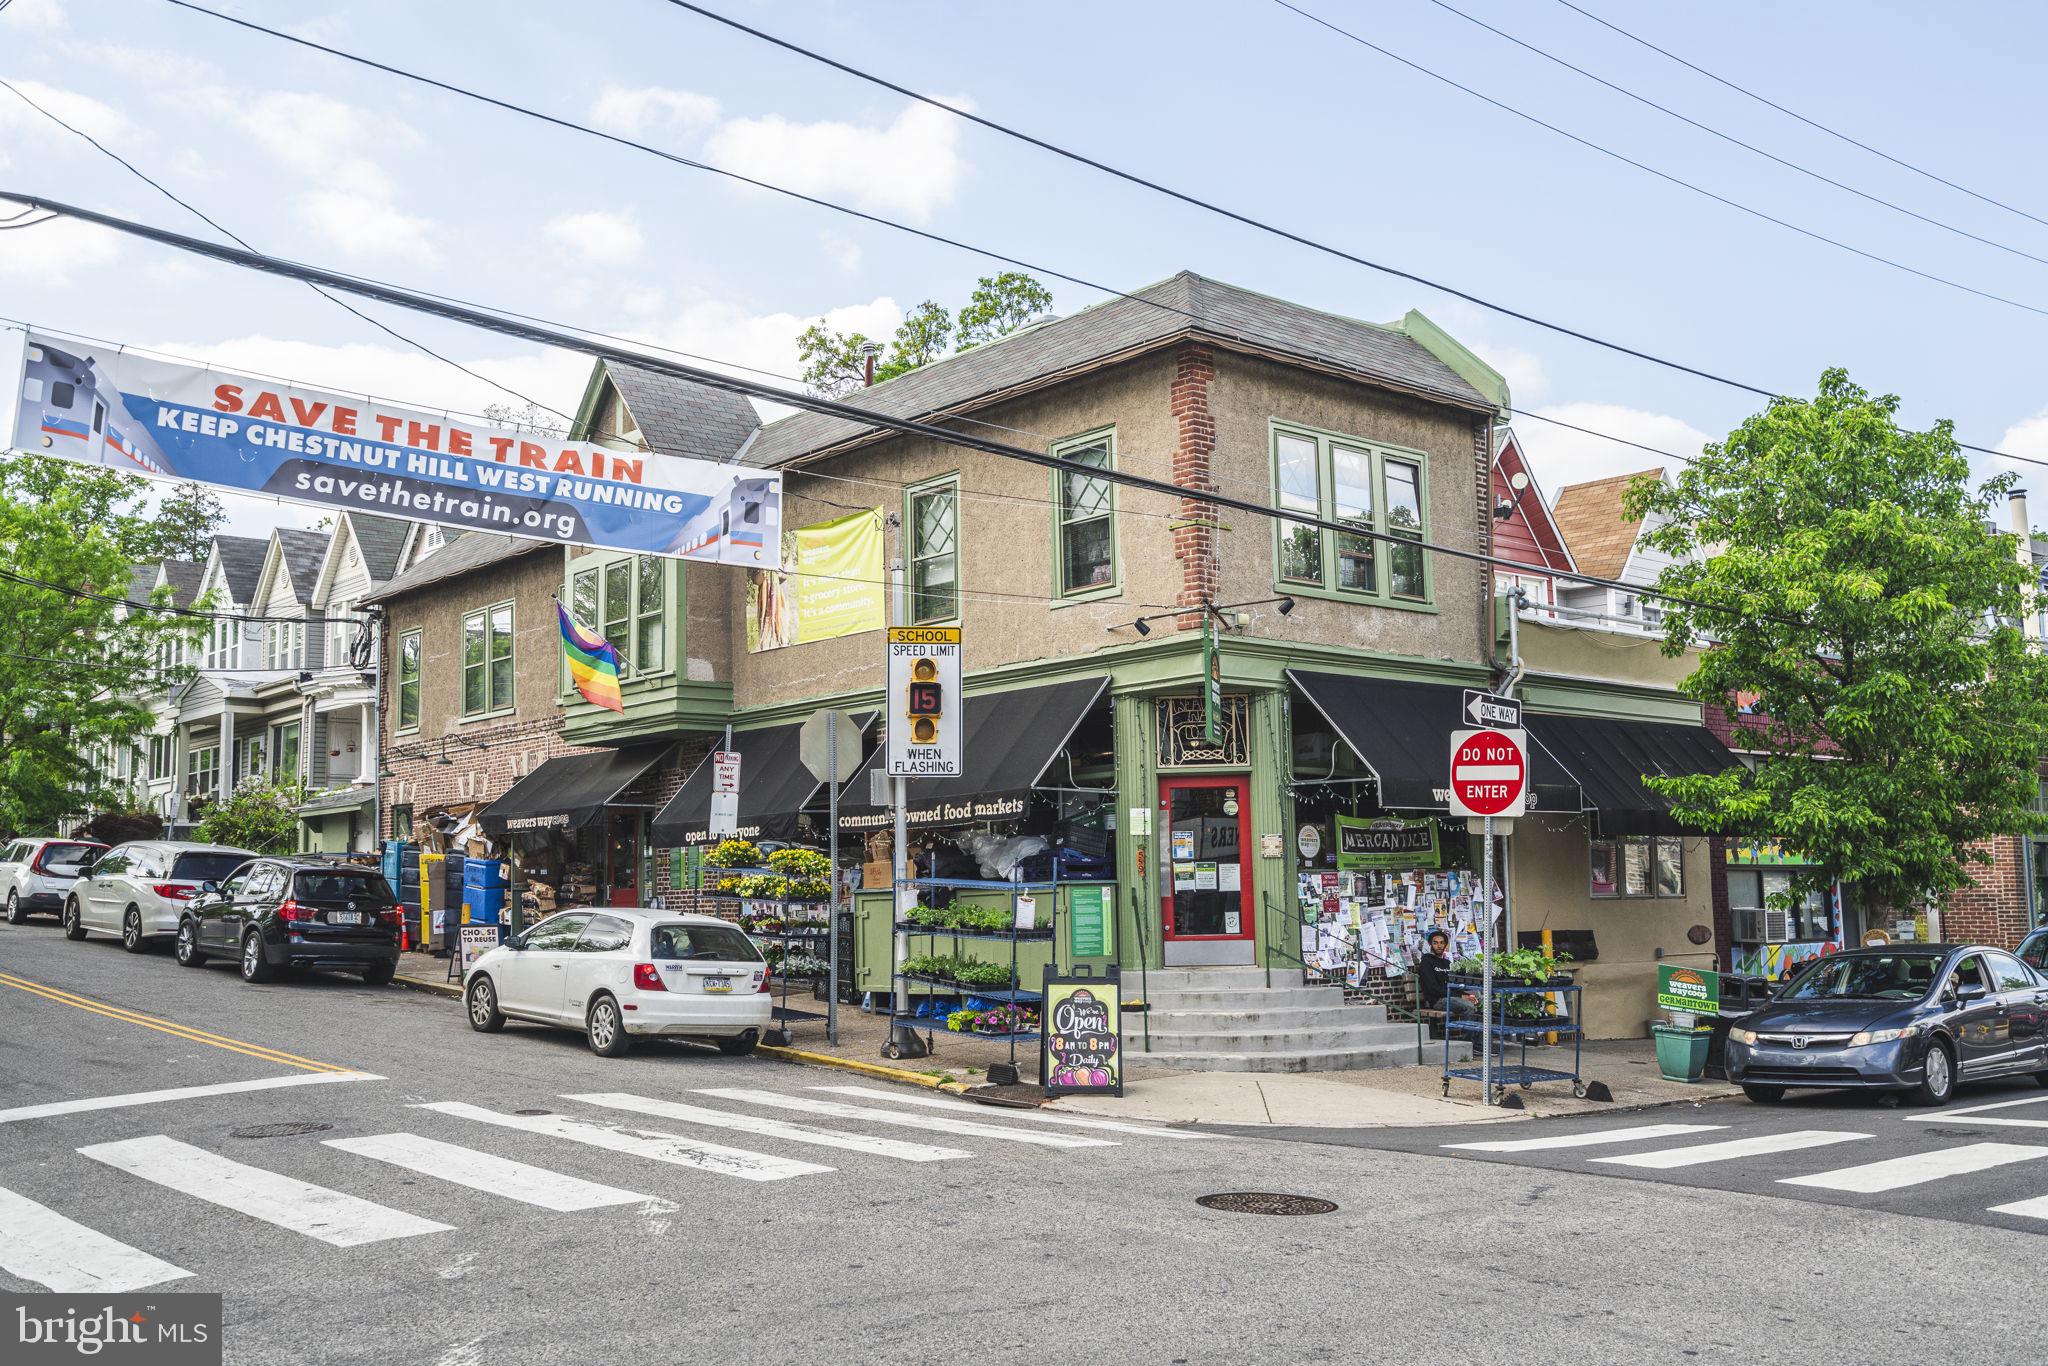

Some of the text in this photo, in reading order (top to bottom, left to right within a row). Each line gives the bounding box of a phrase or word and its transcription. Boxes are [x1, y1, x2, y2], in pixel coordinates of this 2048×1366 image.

[213, 383, 644, 485] SAVE THE TRAIN
[156, 406, 684, 514] KEEP CHESTNUT HILL WEST RUNNING
[295, 472, 576, 539] savethetrain.org
[897, 630, 953, 642] SCHOOL
[893, 645, 956, 656] SPEED LIMIT
[913, 687, 937, 710] 15
[1481, 703, 1515, 722] ONE WAY
[908, 748, 942, 760] WHEN
[1462, 747, 1514, 761] DO NOT
[895, 761, 954, 773] FLASHING
[1466, 785, 1508, 798] ENTER
[944, 801, 971, 819] food
[975, 798, 1024, 815] markets
[506, 817, 537, 829] weavers
[537, 816, 552, 828] way
[685, 831, 707, 845] open
[1344, 832, 1429, 850] MERCANTILE
[1669, 981, 1706, 991] weavers
[1669, 986, 1707, 999] way coop
[1056, 1004, 1107, 1039] Open
[1055, 1037, 1110, 1051] 8 AM TO 8 PM
[1069, 1053, 1100, 1067] Daily
